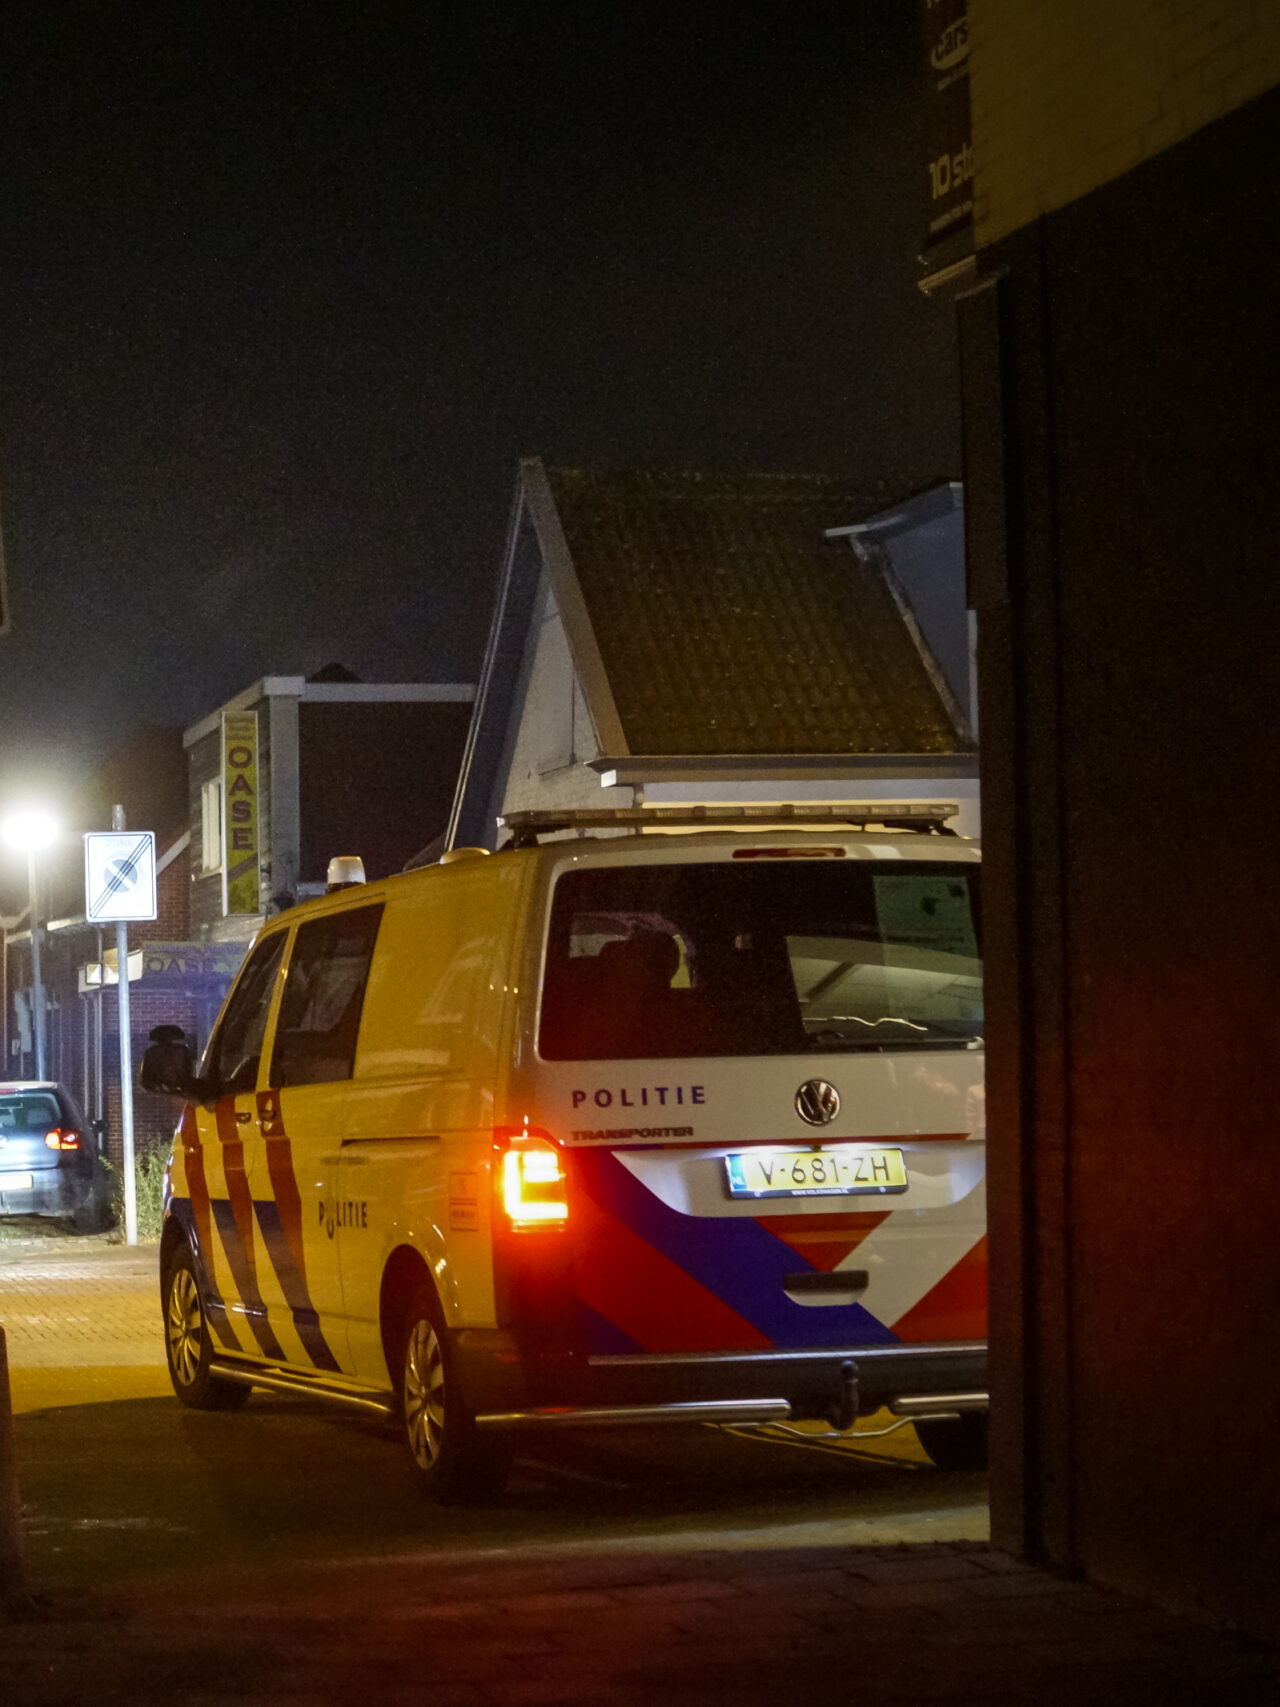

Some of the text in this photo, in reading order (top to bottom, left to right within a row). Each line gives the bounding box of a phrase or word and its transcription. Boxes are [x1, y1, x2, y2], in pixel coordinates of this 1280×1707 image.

[228, 746, 254, 850] OASE
[146, 957, 217, 975] OASE
[572, 1086, 705, 1108] POLITIE
[571, 1127, 693, 1140] TRANSPORTER
[758, 1155, 890, 1186] V-681-ZH
